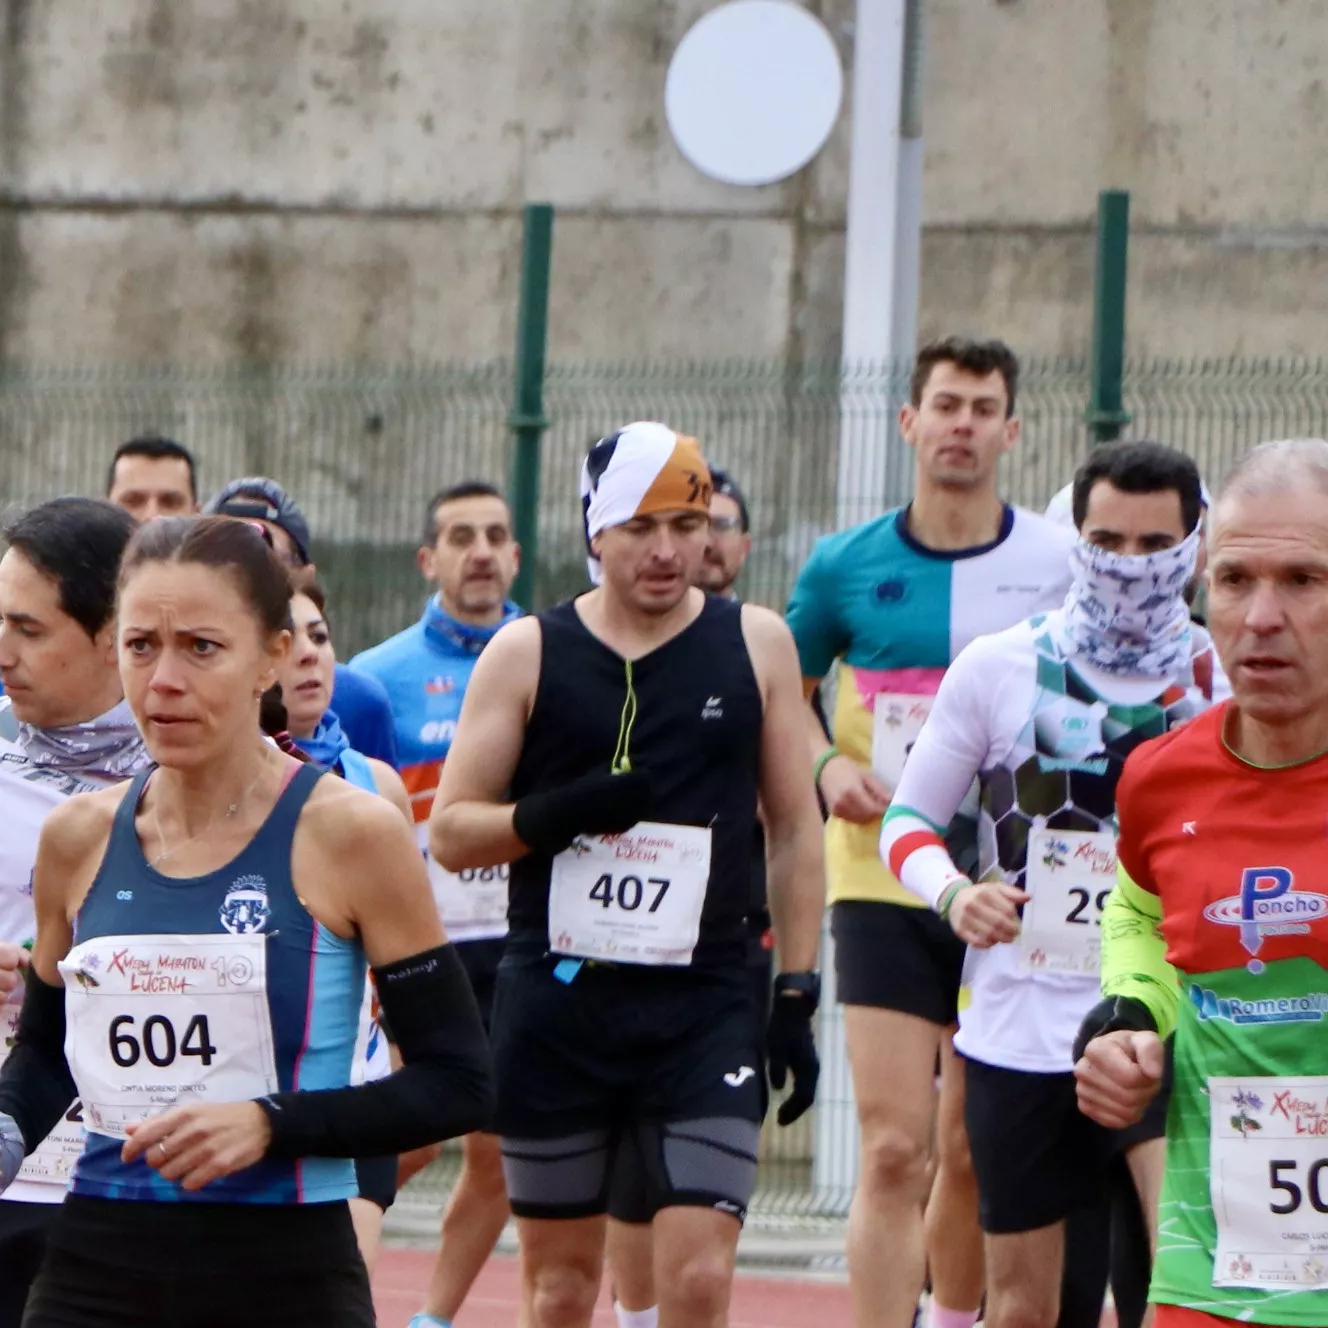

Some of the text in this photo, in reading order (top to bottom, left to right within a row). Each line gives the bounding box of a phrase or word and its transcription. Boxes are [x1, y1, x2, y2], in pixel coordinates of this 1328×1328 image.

[589, 873, 671, 913] 407
[1241, 866, 1321, 921] Poncho
[129, 973, 194, 994] LUCENA
[108, 1013, 217, 1068] 604
[1268, 1157, 1328, 1215] 50
